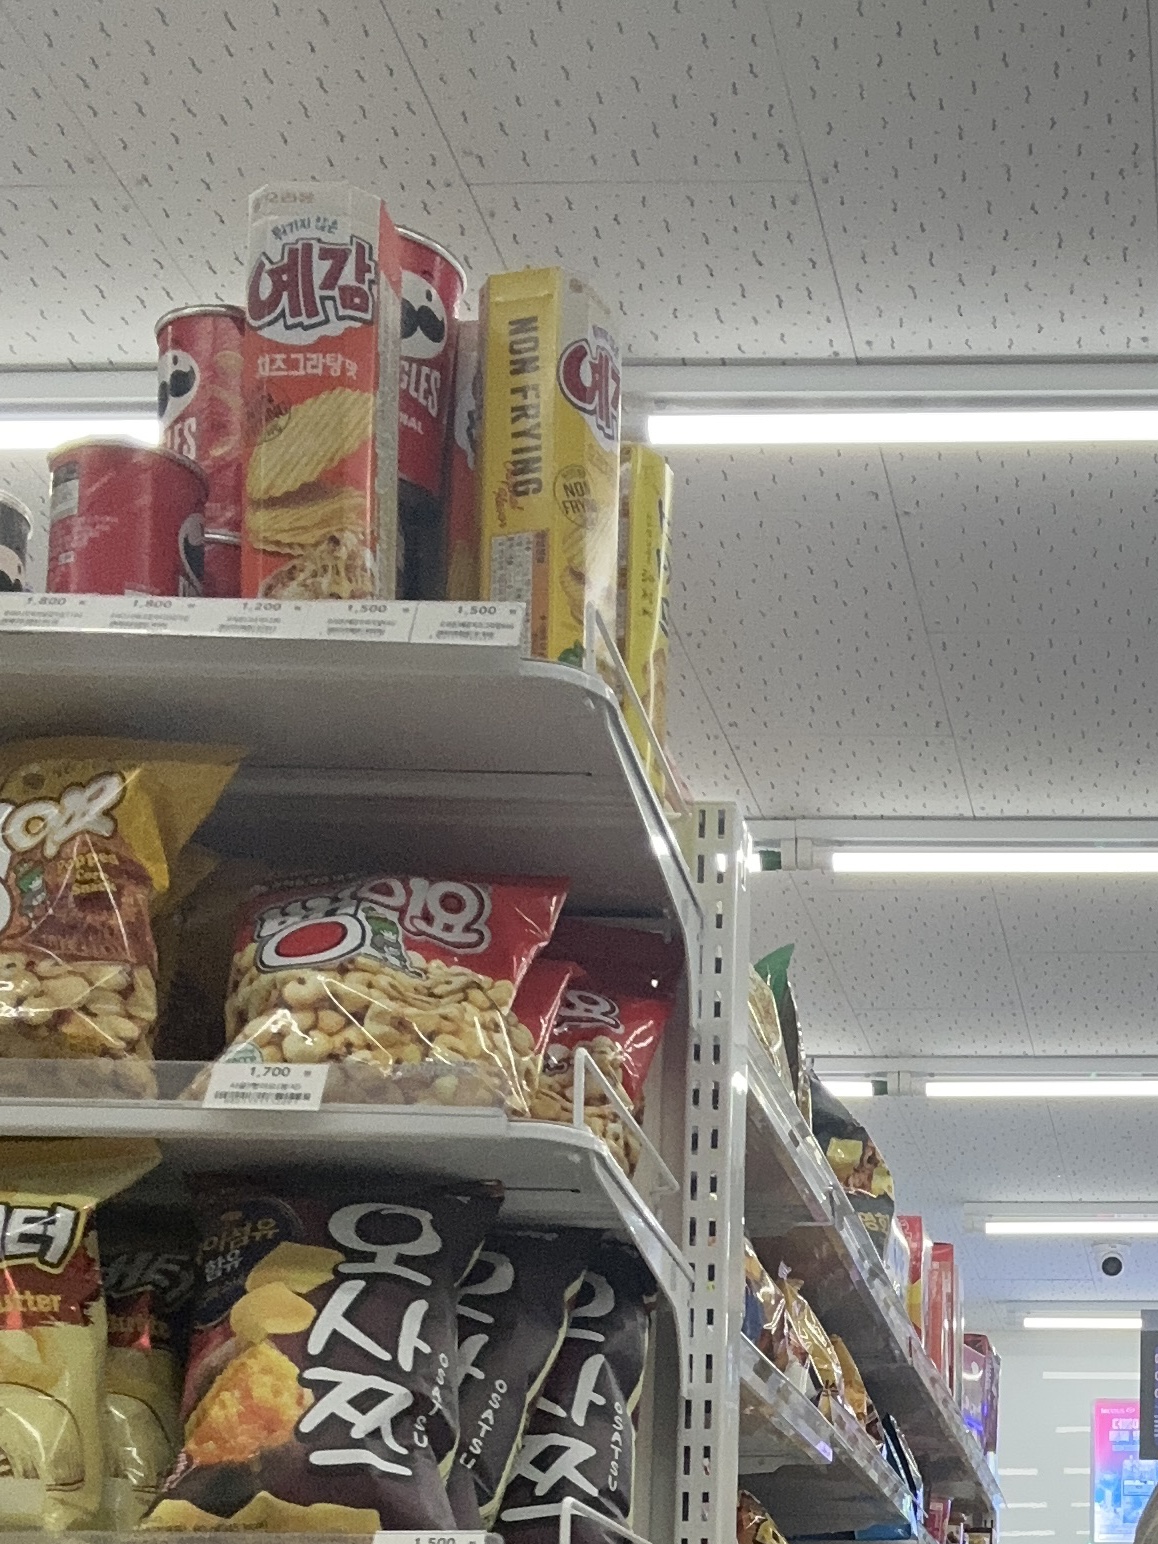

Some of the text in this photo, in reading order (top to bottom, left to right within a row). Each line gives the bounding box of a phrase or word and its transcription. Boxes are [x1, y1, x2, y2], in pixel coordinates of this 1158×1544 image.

[248, 240, 373, 322] 예감
[508, 316, 544, 498] NON FRYING
[249, 1066, 291, 1078] 1,700
[300, 1203, 442, 1475] 오사쯔
[460, 1379, 507, 1470] OSATSU
[605, 1402, 625, 1491] OSATSU
